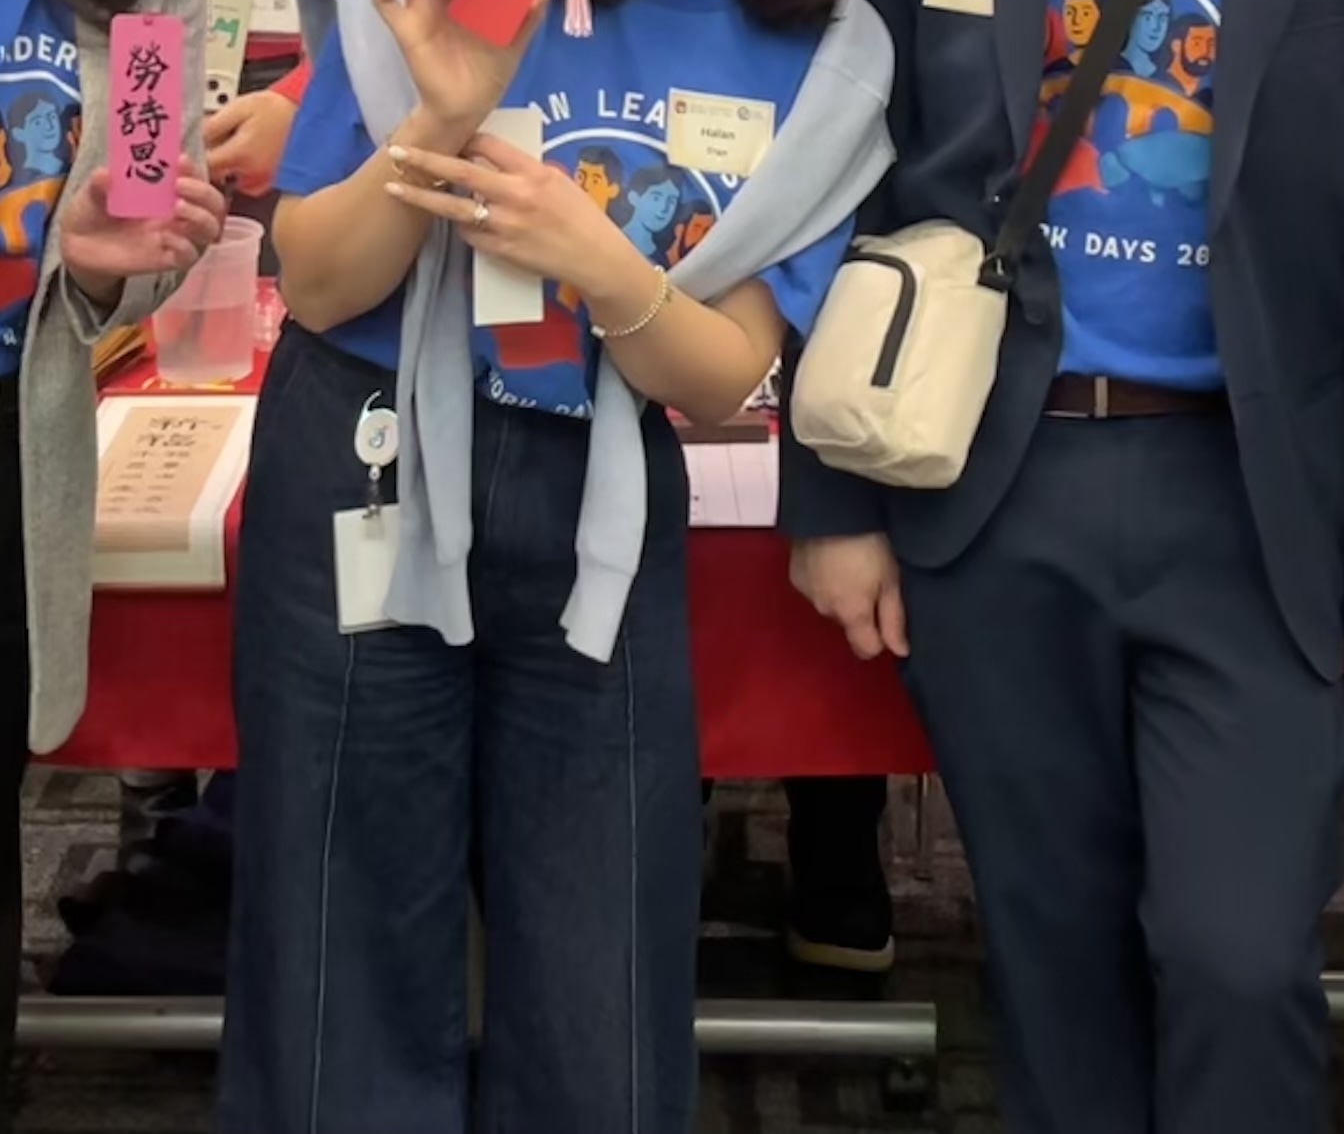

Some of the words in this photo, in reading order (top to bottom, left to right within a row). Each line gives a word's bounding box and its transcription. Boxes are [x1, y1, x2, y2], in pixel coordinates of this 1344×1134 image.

[597, 88, 666, 130] LEA
[1084, 232, 1157, 263] DAYS
[1177, 243, 1211, 266] 20
